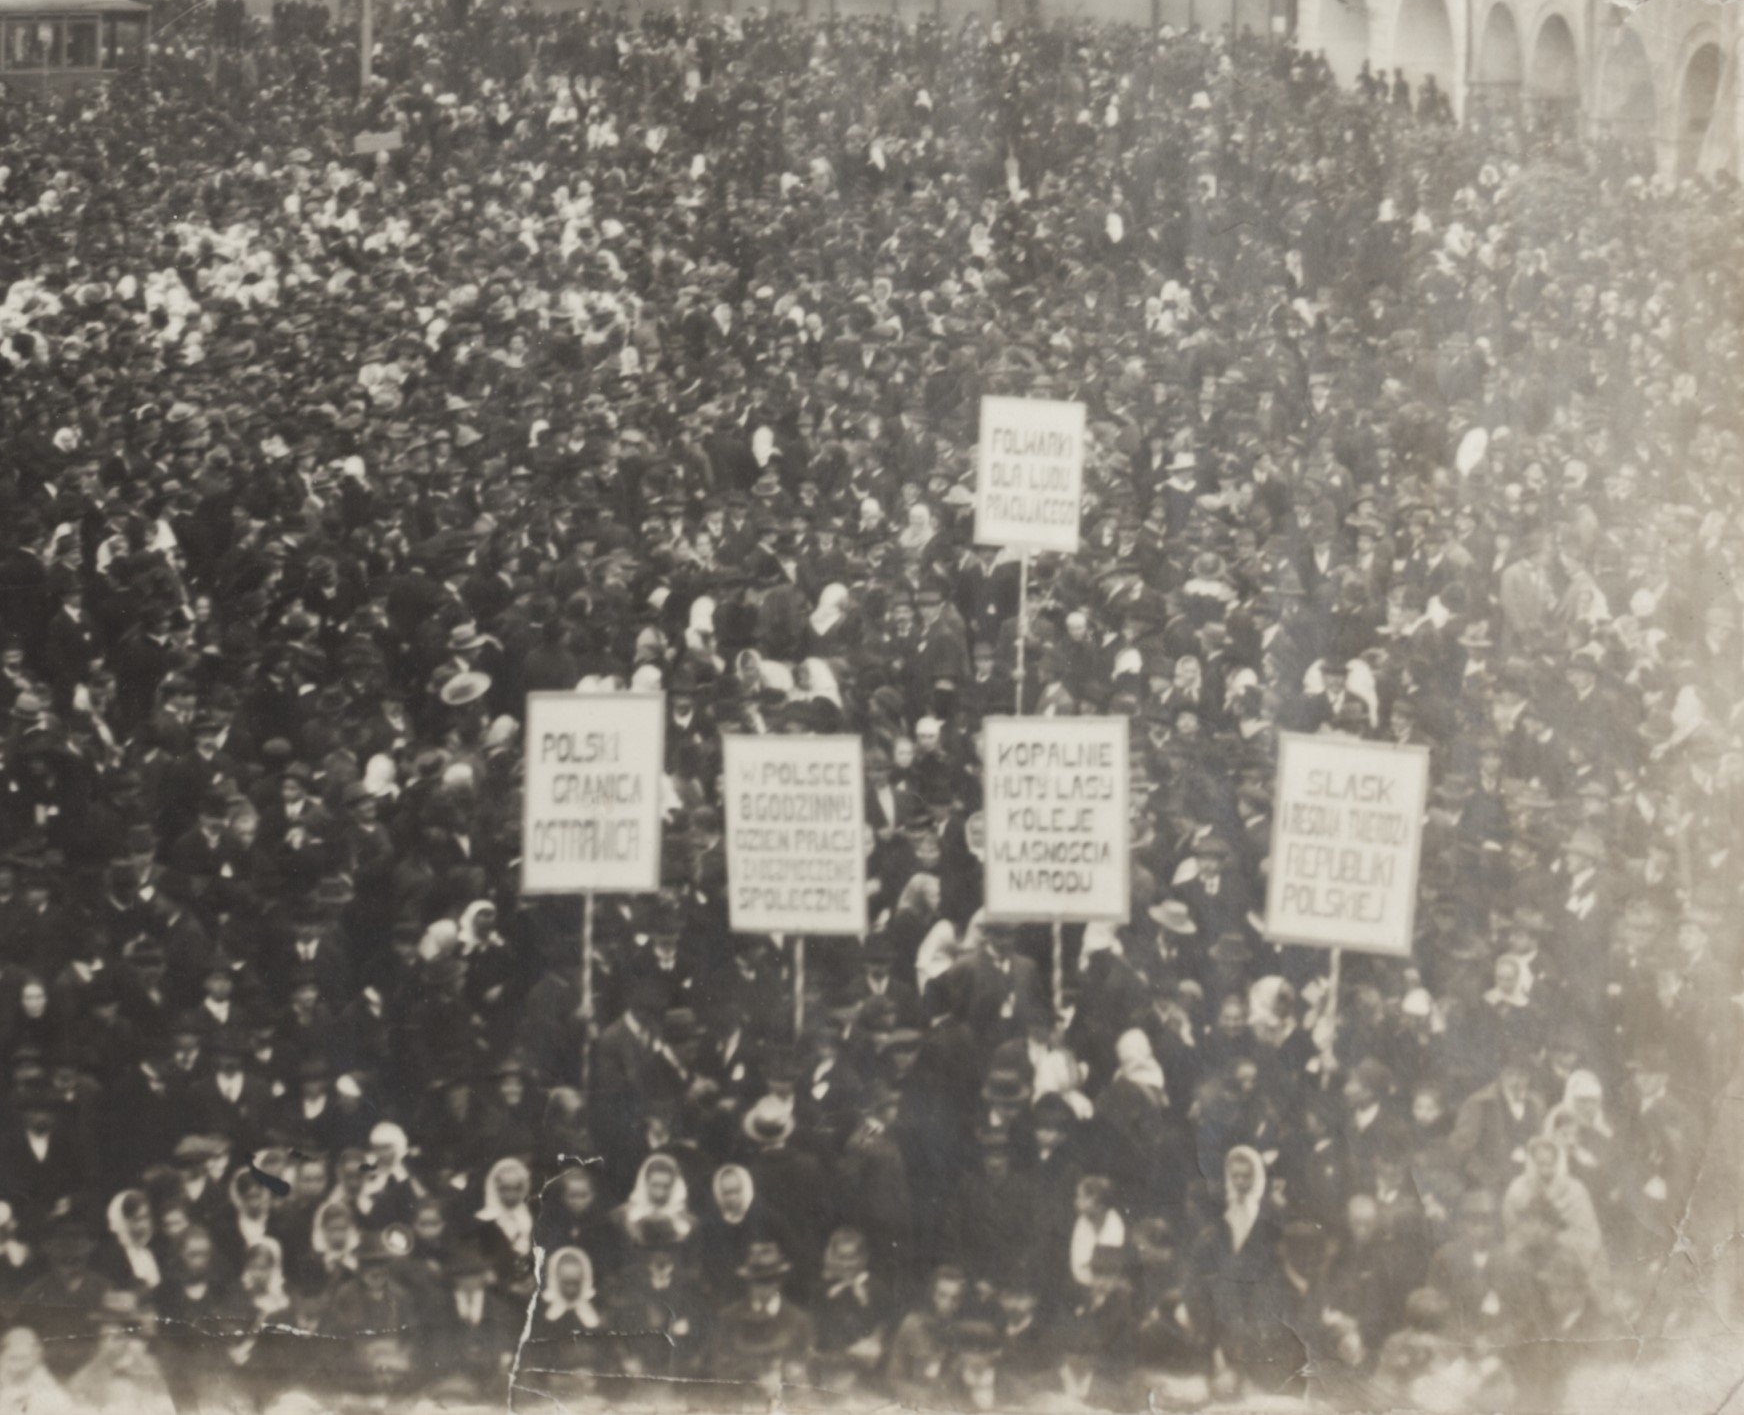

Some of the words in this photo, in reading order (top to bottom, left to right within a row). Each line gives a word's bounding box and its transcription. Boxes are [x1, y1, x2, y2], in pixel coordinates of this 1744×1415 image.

[991, 462, 1021, 488] DLA
[1030, 465, 1071, 493] LUDU
[998, 742, 1113, 768] KOPALNIE
[761, 762, 851, 786] POLSCE
[994, 775, 1048, 800] HUTY
[1056, 775, 1113, 800] LASY
[741, 792, 752, 821] 8
[756, 792, 853, 822] GODZINNY
[1008, 807, 1094, 832] KOLEJE
[794, 828, 855, 852] PRACY
[1286, 842, 1396, 888] REPUBLIKI
[1008, 869, 1093, 894] NARODU
[1281, 882, 1386, 923] POLSKIEJ
